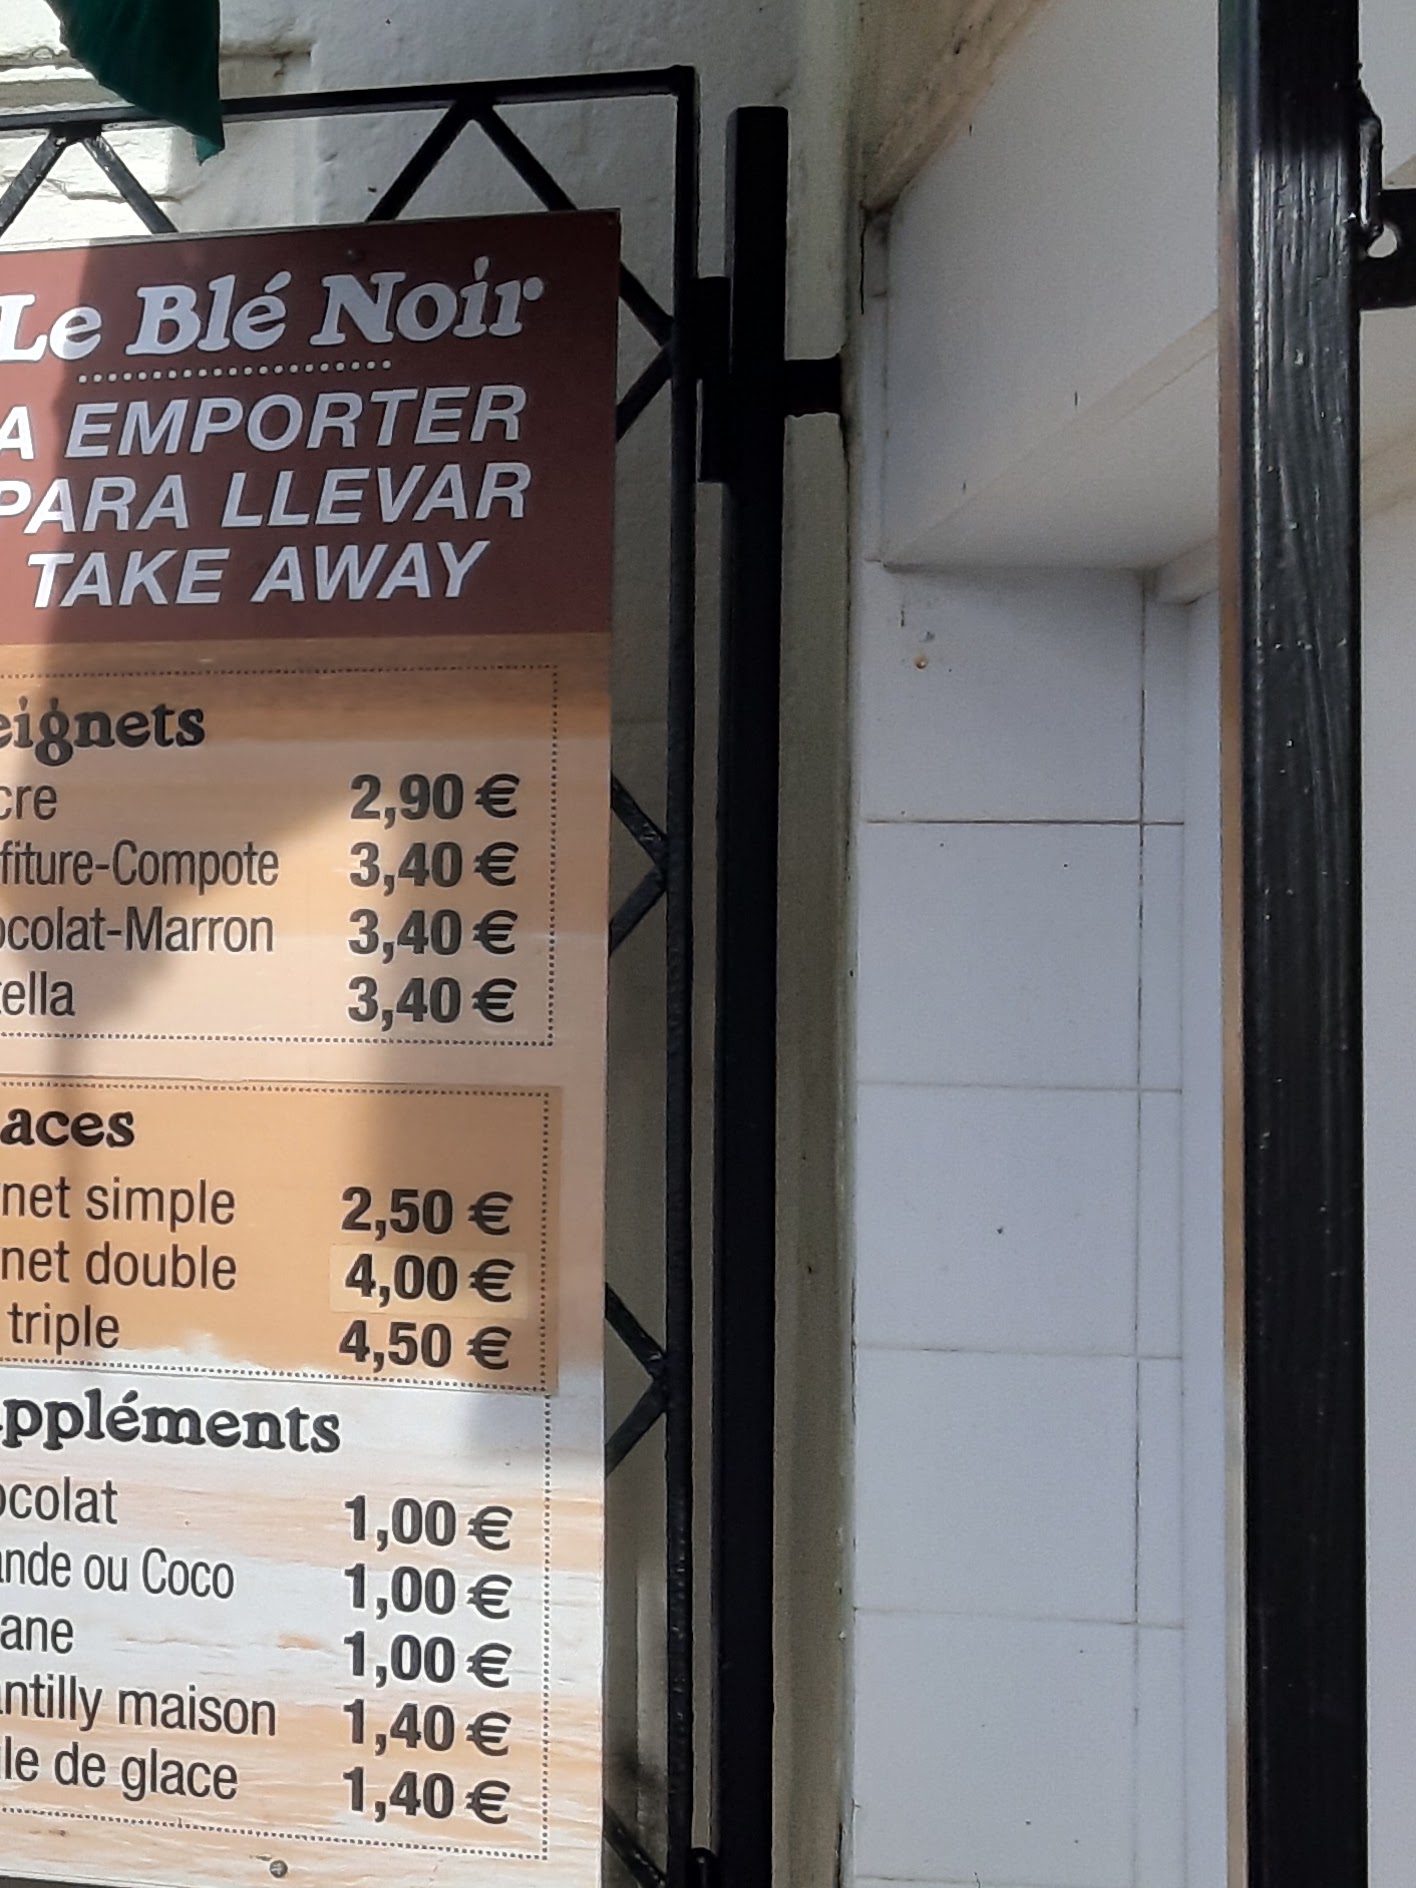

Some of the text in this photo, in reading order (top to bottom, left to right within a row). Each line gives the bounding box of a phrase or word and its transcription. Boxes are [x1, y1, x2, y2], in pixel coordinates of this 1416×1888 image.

[125, 270, 292, 356] Blé
[309, 255, 544, 346] Noir
[63, 384, 527, 459] EMPORTER
[220, 461, 532, 529] LLEVAR
[27, 540, 491, 609] TAKE AWAY
[85, 1176, 235, 1234] simple
[85, 1240, 237, 1291] double
[9, 1302, 120, 1355] triple
[83, 1554, 128, 1592] ou
[142, 1547, 235, 1600] Coco
[118, 1684, 276, 1737] maison
[54, 1741, 106, 1789] de
[121, 1747, 238, 1802] glace
